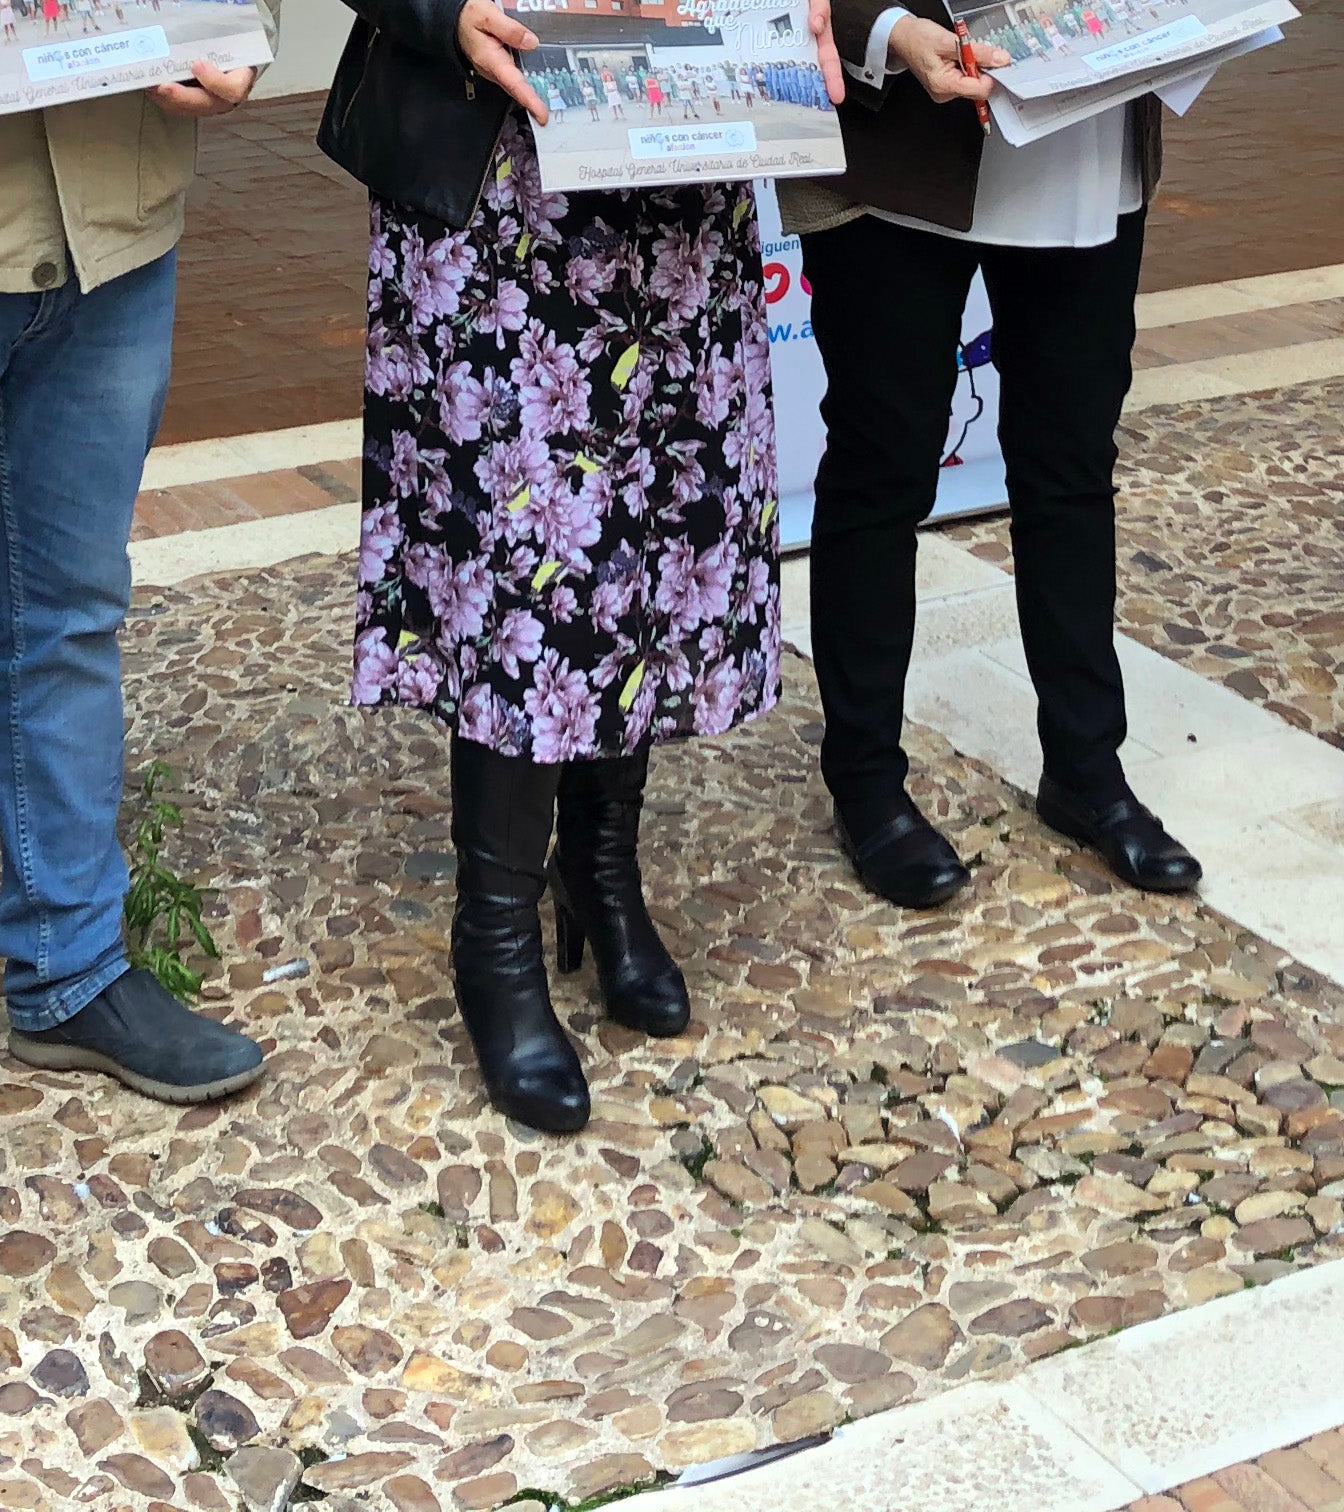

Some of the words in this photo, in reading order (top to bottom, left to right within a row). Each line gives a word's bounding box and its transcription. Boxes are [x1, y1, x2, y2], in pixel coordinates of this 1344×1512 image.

[703, 13, 739, 35] que
[735, 22, 810, 56] Nunca
[72, 47, 92, 59] con
[672, 132, 690, 142] con
[578, 165, 623, 181] Hospital
[625, 162, 666, 180] General
[736, 158, 748, 169] de
[750, 154, 785, 169] Ciudad
[788, 152, 814, 165] Real
